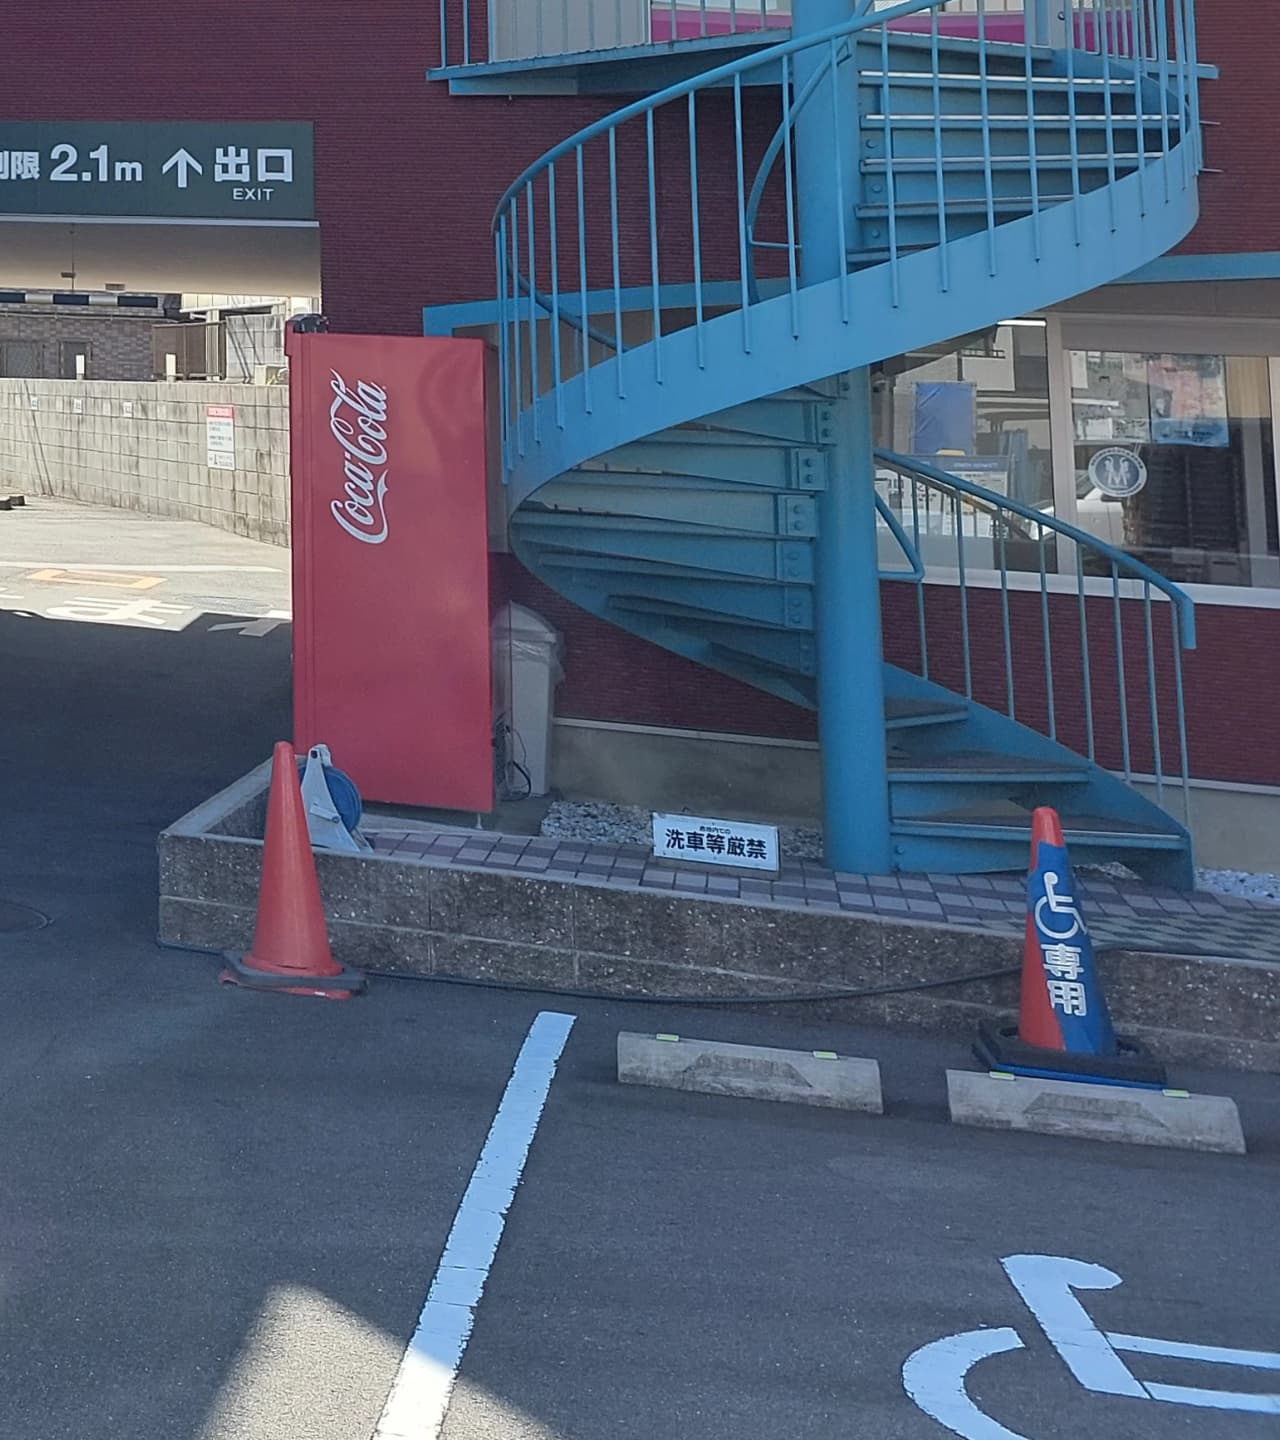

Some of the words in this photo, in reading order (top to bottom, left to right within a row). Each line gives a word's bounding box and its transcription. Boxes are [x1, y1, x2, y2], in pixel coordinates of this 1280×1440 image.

[49, 144, 143, 182] 2.1m
[213, 145, 293, 183] 出口
[232, 188, 274, 201] EXIT
[328, 367, 389, 545] Coca-Cola
[665, 828, 767, 860] 洗車等厳禁
[1040, 943, 1088, 1017] 専用
